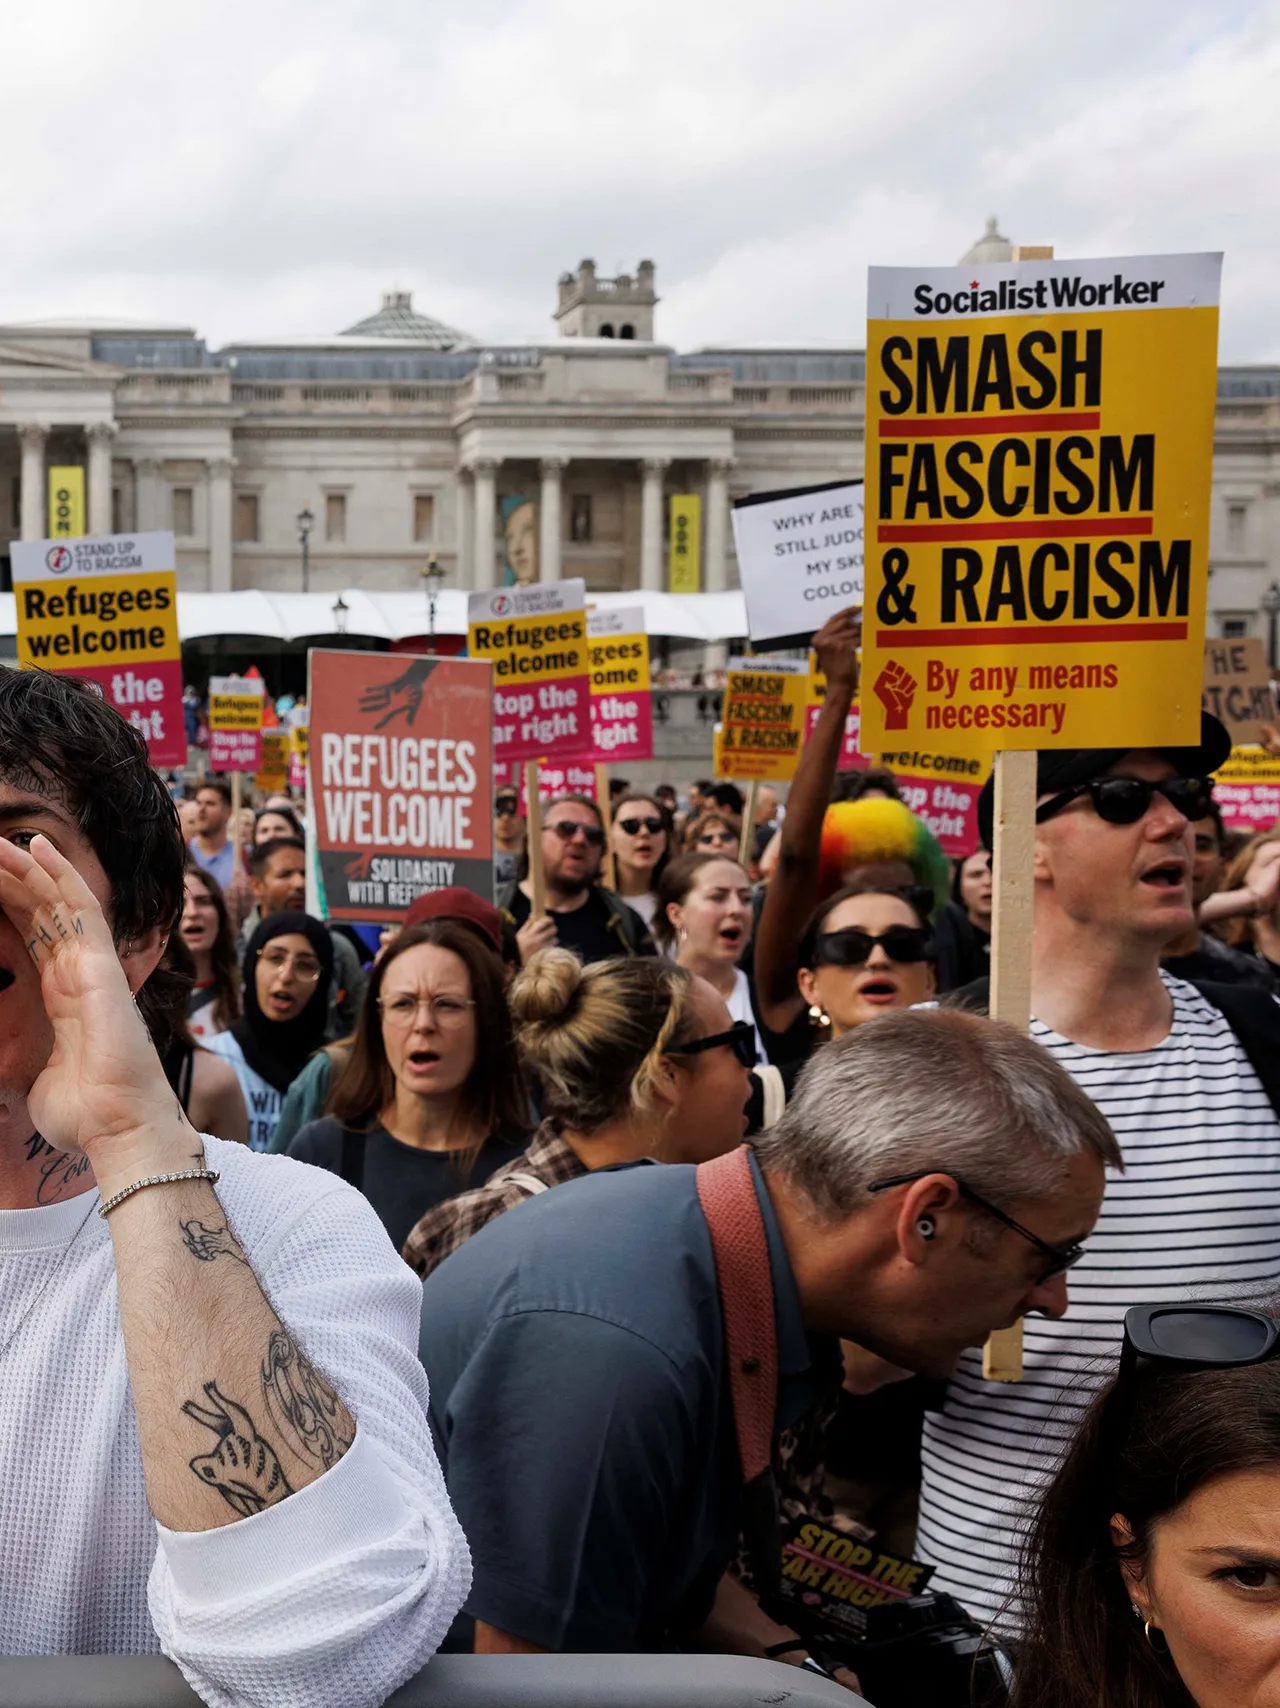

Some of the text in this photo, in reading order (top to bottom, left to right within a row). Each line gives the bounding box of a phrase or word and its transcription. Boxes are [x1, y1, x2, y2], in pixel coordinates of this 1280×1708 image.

[914, 275, 1165, 314] Socialist Worker
[879, 329, 1103, 415] SMASH
[879, 434, 1155, 520] FASCISM
[773, 512, 815, 532] WHY
[820, 504, 854, 523] ARE
[74, 541, 135, 557] STAND UP
[774, 538, 820, 557] STILL
[75, 555, 143, 571] TO RACISM
[806, 560, 832, 576] MY
[877, 540, 1192, 626] & RACISM
[23, 585, 171, 622] Refugees
[26, 624, 166, 658] welcome
[474, 621, 582, 650] Refugees
[496, 649, 579, 676] elcome
[592, 642, 642, 665] gees
[1211, 646, 1249, 675] HE
[112, 672, 164, 705] the
[731, 676, 786, 696] SMASH
[926, 660, 1119, 699] By any means
[493, 685, 578, 719] top the
[600, 696, 639, 720] the
[728, 702, 793, 722] FASCISM
[493, 712, 578, 744] ar right
[926, 702, 1067, 734] necessary
[591, 722, 639, 750] ight
[741, 728, 800, 748] RACISM
[321, 732, 477, 793] REFUGEES
[881, 750, 981, 776] welcome
[933, 785, 971, 811] the
[322, 790, 474, 850] WELCOME
[922, 811, 965, 838] ight
[371, 858, 455, 886] SOLIDARITY
[347, 881, 384, 904] WITH
[793, 1523, 925, 1592] STOP THE
